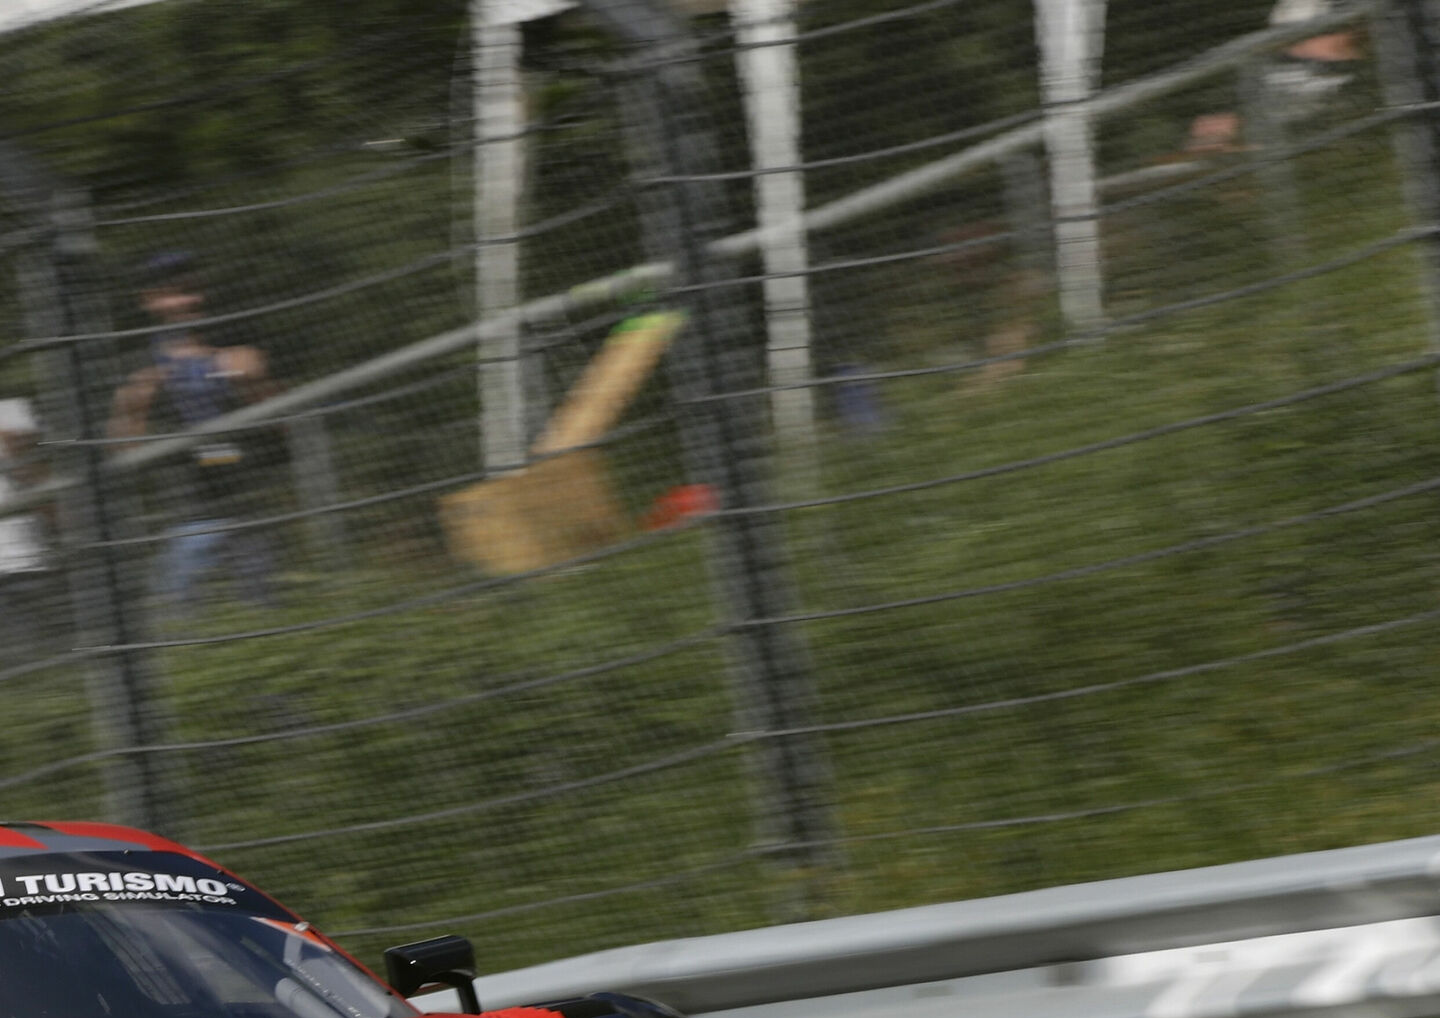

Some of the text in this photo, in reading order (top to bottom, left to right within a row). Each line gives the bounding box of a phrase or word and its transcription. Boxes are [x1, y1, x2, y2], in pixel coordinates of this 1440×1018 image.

[16, 872, 228, 896] TURISMO
[3, 893, 100, 907] DRIVING
[103, 891, 237, 906] SIMULATOR
